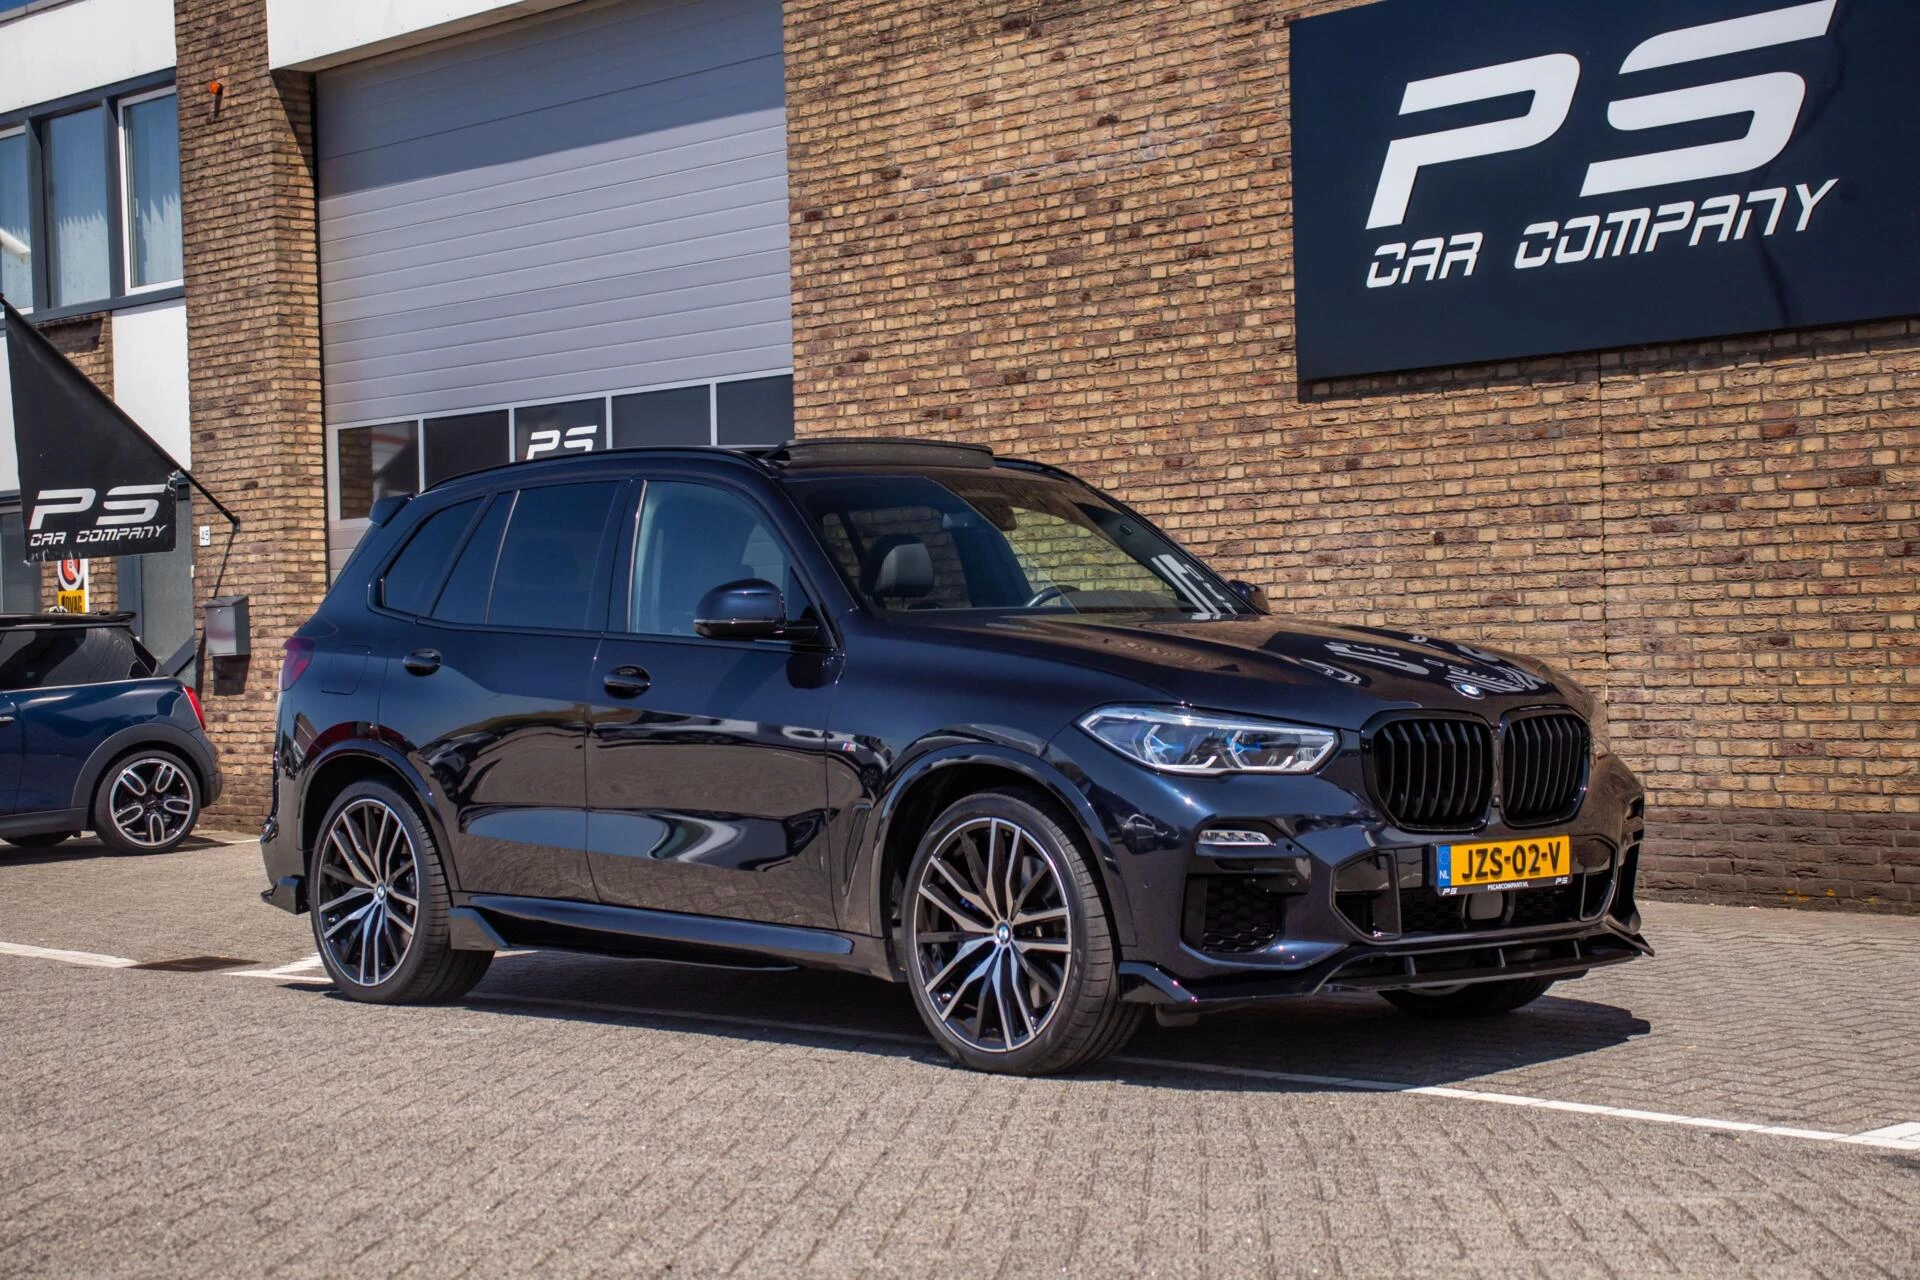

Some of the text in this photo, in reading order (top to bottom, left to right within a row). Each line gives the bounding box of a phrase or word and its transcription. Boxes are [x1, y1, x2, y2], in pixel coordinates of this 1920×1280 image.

[1366, 0, 1838, 230] PS
[1366, 178, 1839, 289] CAR COMPANY
[29, 484, 167, 530] PS
[30, 524, 167, 547] CAR COMPANY
[1439, 841, 1561, 880] NL JZS-02-V
